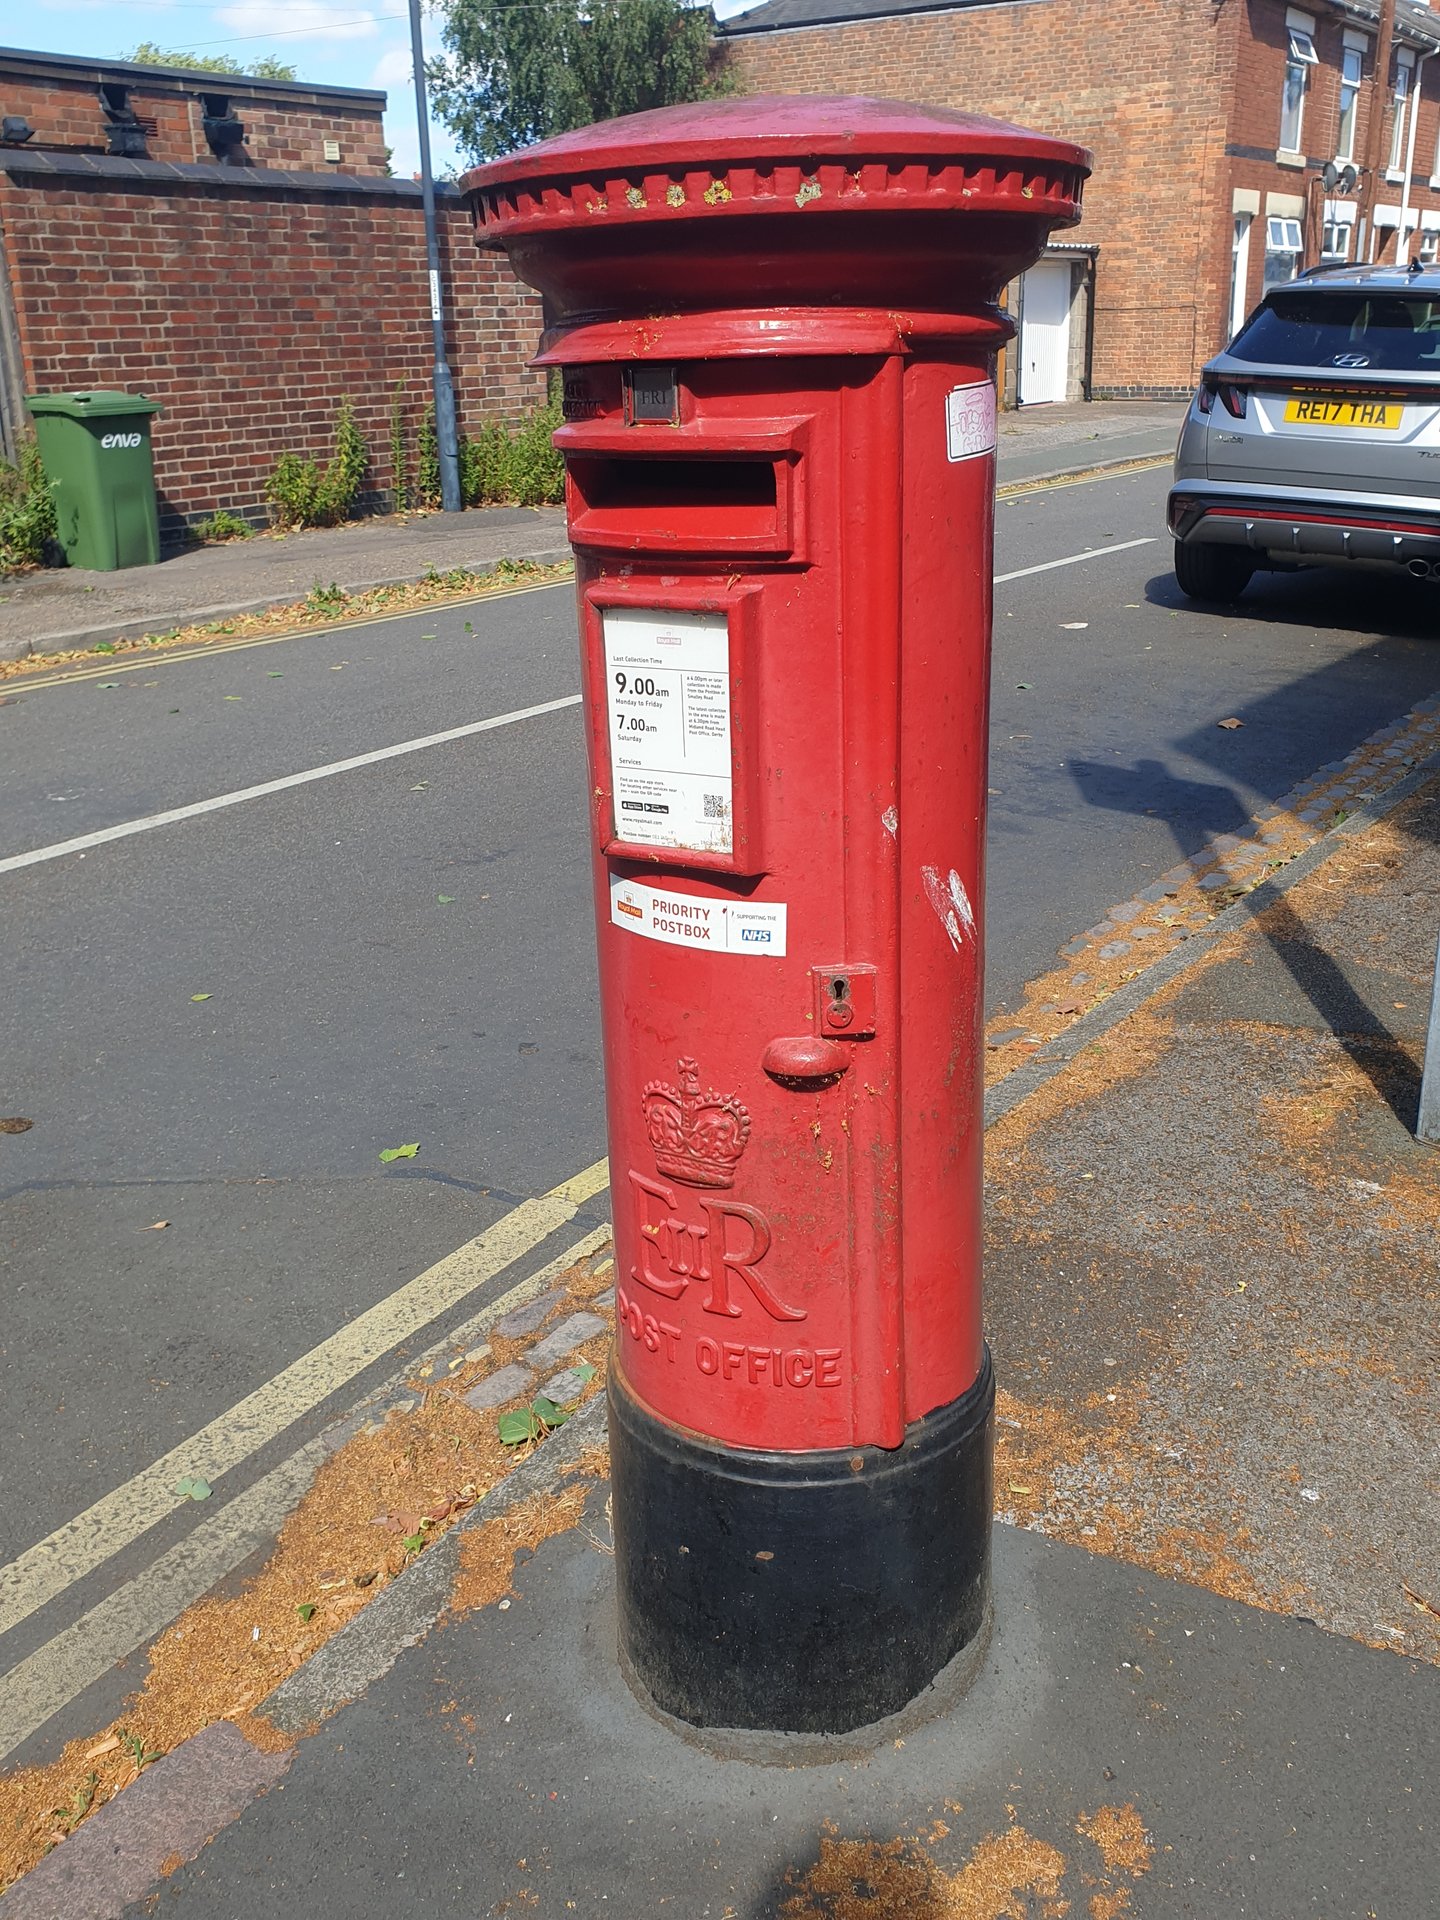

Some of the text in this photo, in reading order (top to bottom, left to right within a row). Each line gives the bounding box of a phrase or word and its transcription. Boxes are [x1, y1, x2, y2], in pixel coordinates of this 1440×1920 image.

[641, 390, 667, 405] FRI
[1296, 400, 1386, 424] RE17 THA
[101, 432, 142, 448] enva
[625, 656, 649, 664] Collection
[616, 672, 670, 697] 9.00am
[616, 698, 637, 707] Monday
[645, 700, 663, 709] Friday
[616, 714, 658, 733] 7.00am
[618, 734, 642, 743] Saturday
[619, 757, 642, 765] Services
[618, 902, 630, 912] Royal
[652, 898, 710, 921] PRIORITY
[653, 917, 711, 940] POSTBOX
[742, 930, 770, 941] NHS
[619, 1287, 843, 1388] POST OFFICE
